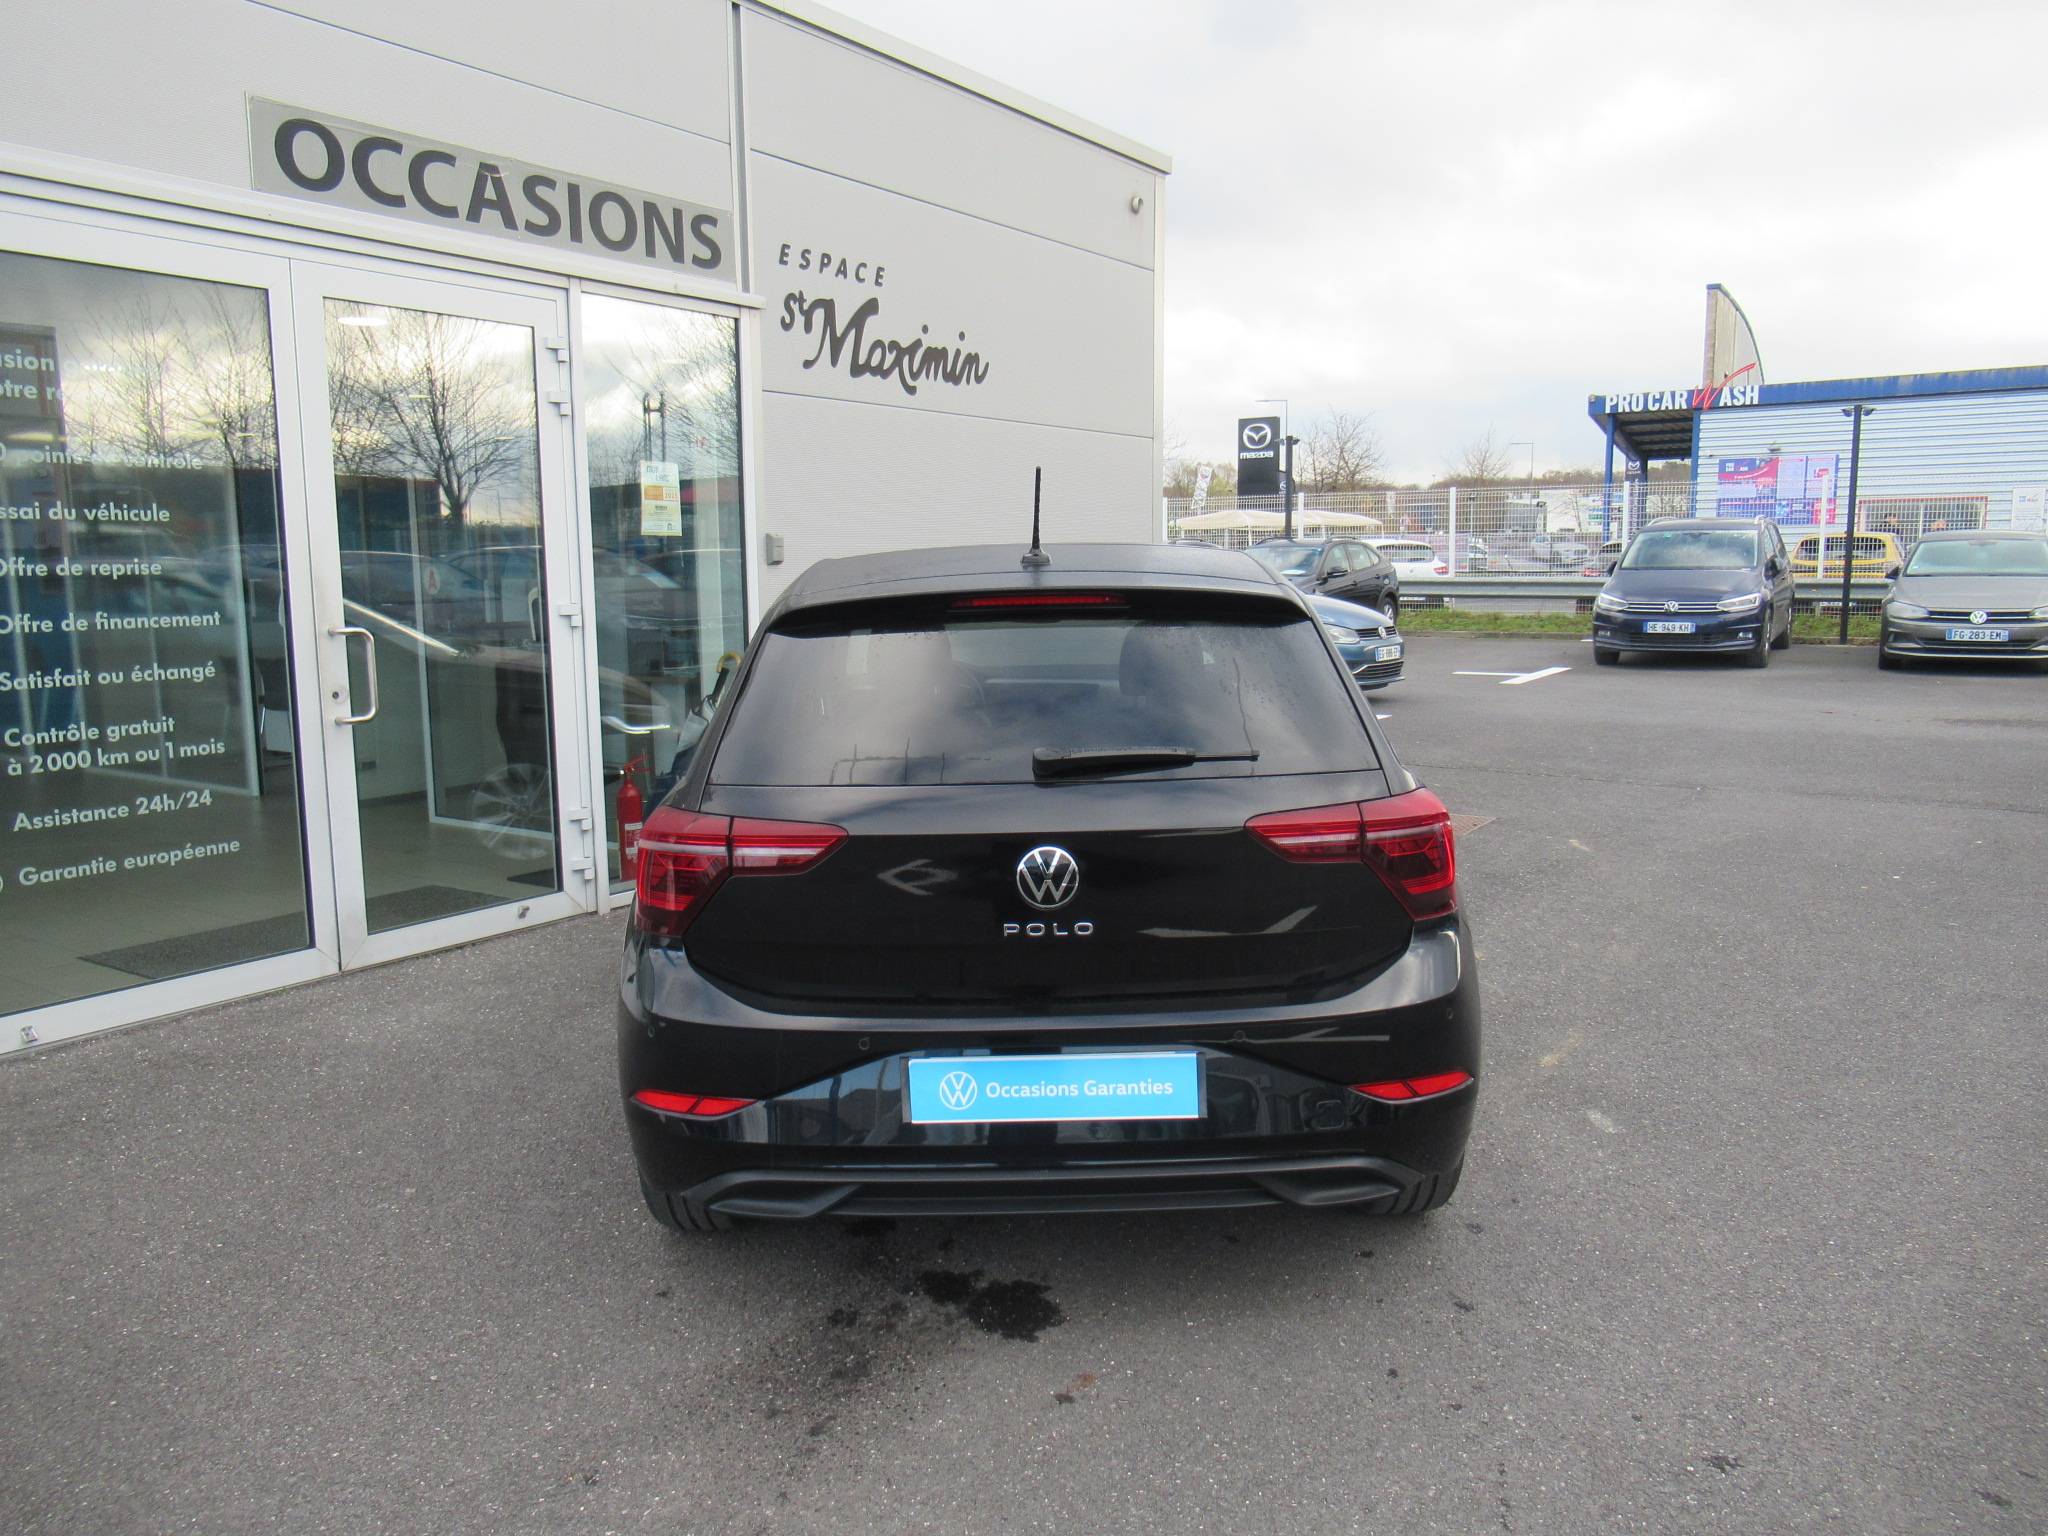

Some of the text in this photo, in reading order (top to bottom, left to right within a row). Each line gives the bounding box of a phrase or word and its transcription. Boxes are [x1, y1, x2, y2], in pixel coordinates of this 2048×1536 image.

[274, 118, 722, 269] OCCASIONS
[778, 243, 886, 287] ESPACE
[803, 297, 990, 396] Maximin
[1605, 362, 1760, 414] PRO CAR WASH
[48, 501, 76, 521] du
[84, 502, 171, 522] véhicule
[55, 557, 83, 576] de
[91, 558, 163, 580] reprise
[0, 610, 222, 634] Offre de financement
[0, 660, 216, 691] Satisfait ou échangé
[4, 716, 176, 747] Contrôle gratuit
[7, 758, 22, 776] à
[97, 748, 129, 767] km
[135, 747, 160, 763] ou
[165, 742, 174, 758] 1
[180, 738, 225, 758] mois
[12, 788, 213, 832] Assistance 24h/24
[19, 839, 241, 886] Garantie européenne
[1003, 922, 1095, 937] POLO
[985, 1080, 1079, 1099] Occasions
[1083, 1078, 1174, 1097] Garanties
